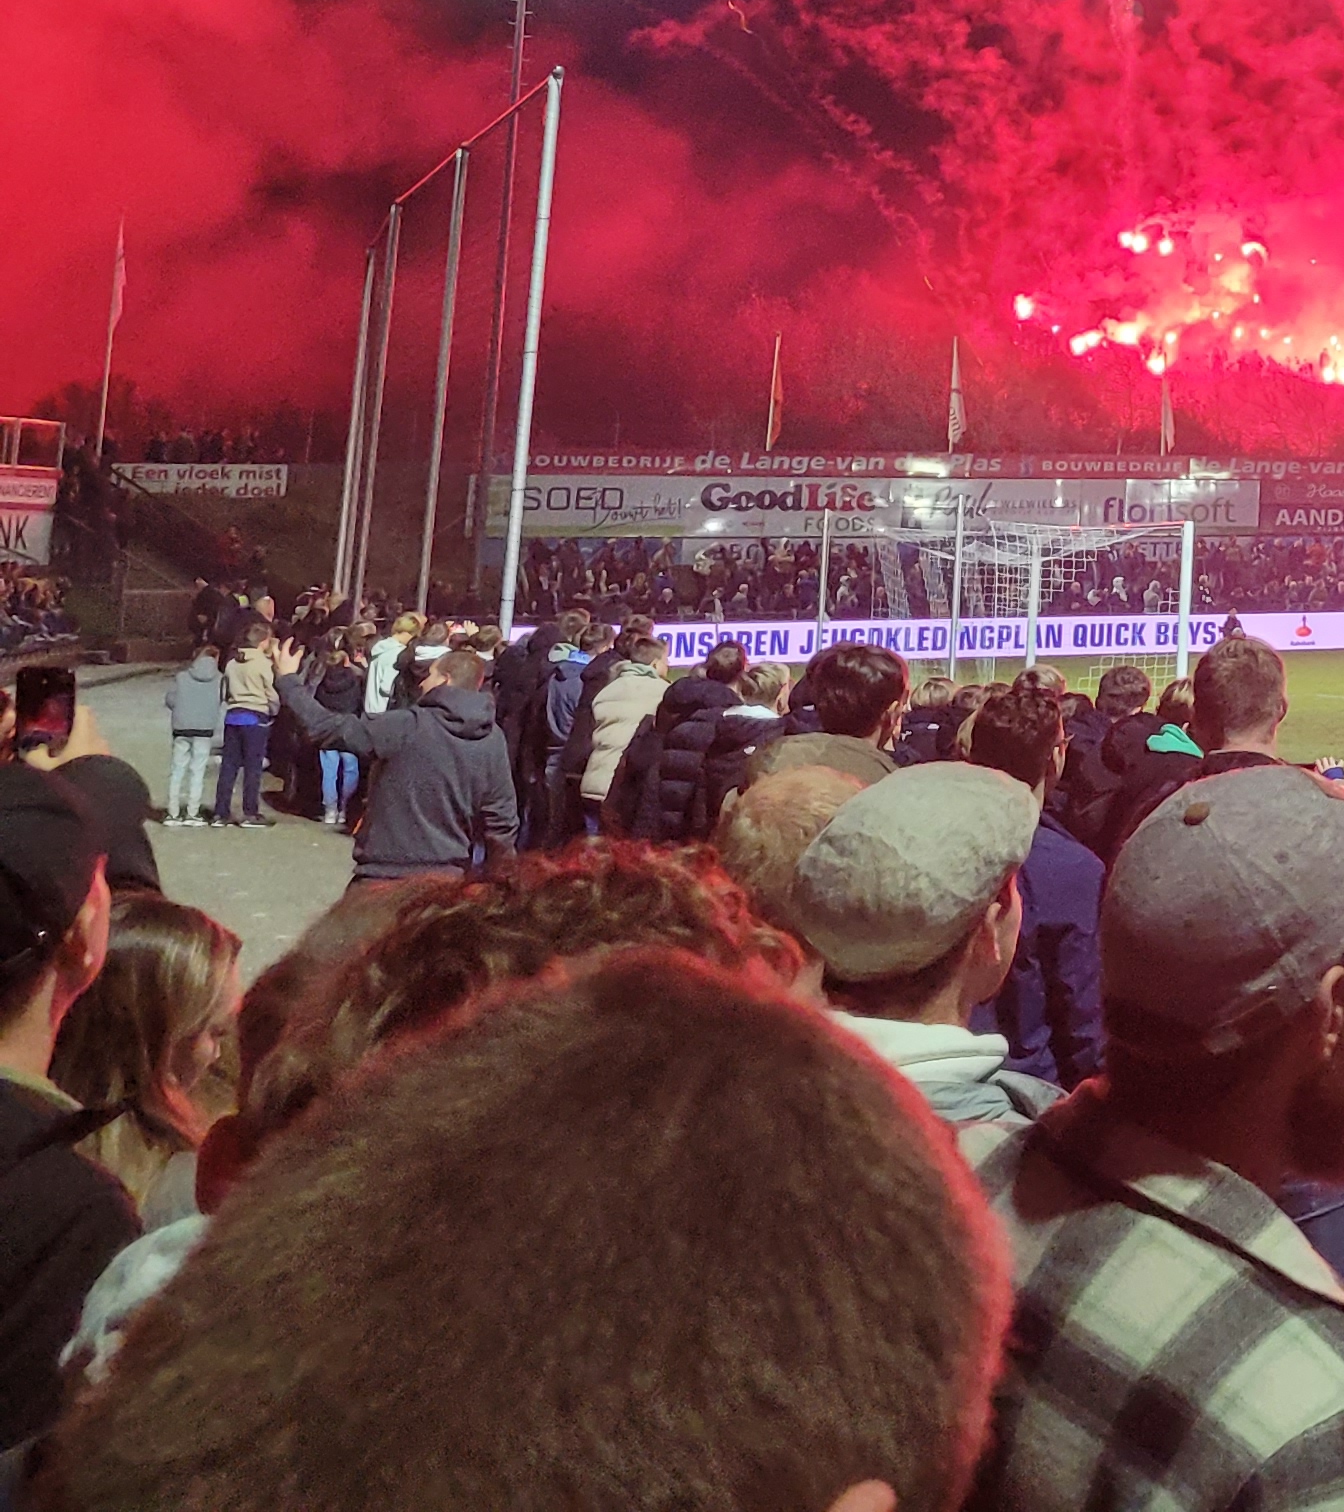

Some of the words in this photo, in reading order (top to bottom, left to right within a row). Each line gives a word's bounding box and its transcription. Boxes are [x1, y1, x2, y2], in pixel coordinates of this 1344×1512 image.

[132, 465, 168, 480] Een
[176, 465, 231, 481] vloek
[238, 465, 283, 480] mist
[529, 454, 686, 468] OUWBEDRIJF
[694, 450, 731, 469] de
[740, 451, 886, 476] Lange-van
[951, 454, 1002, 473] Plas
[1041, 460, 1183, 474] BOUWBEDRIJF
[235, 482, 282, 498] doel
[700, 481, 876, 513] GoodLife
[1103, 496, 1237, 526] florisoft
[658, 629, 791, 659] ONSOREN
[799, 623, 1063, 656] JEUGDKLEDNGPLAN
[1072, 621, 1147, 649] QUICK
[1154, 620, 1218, 647] BOYS
